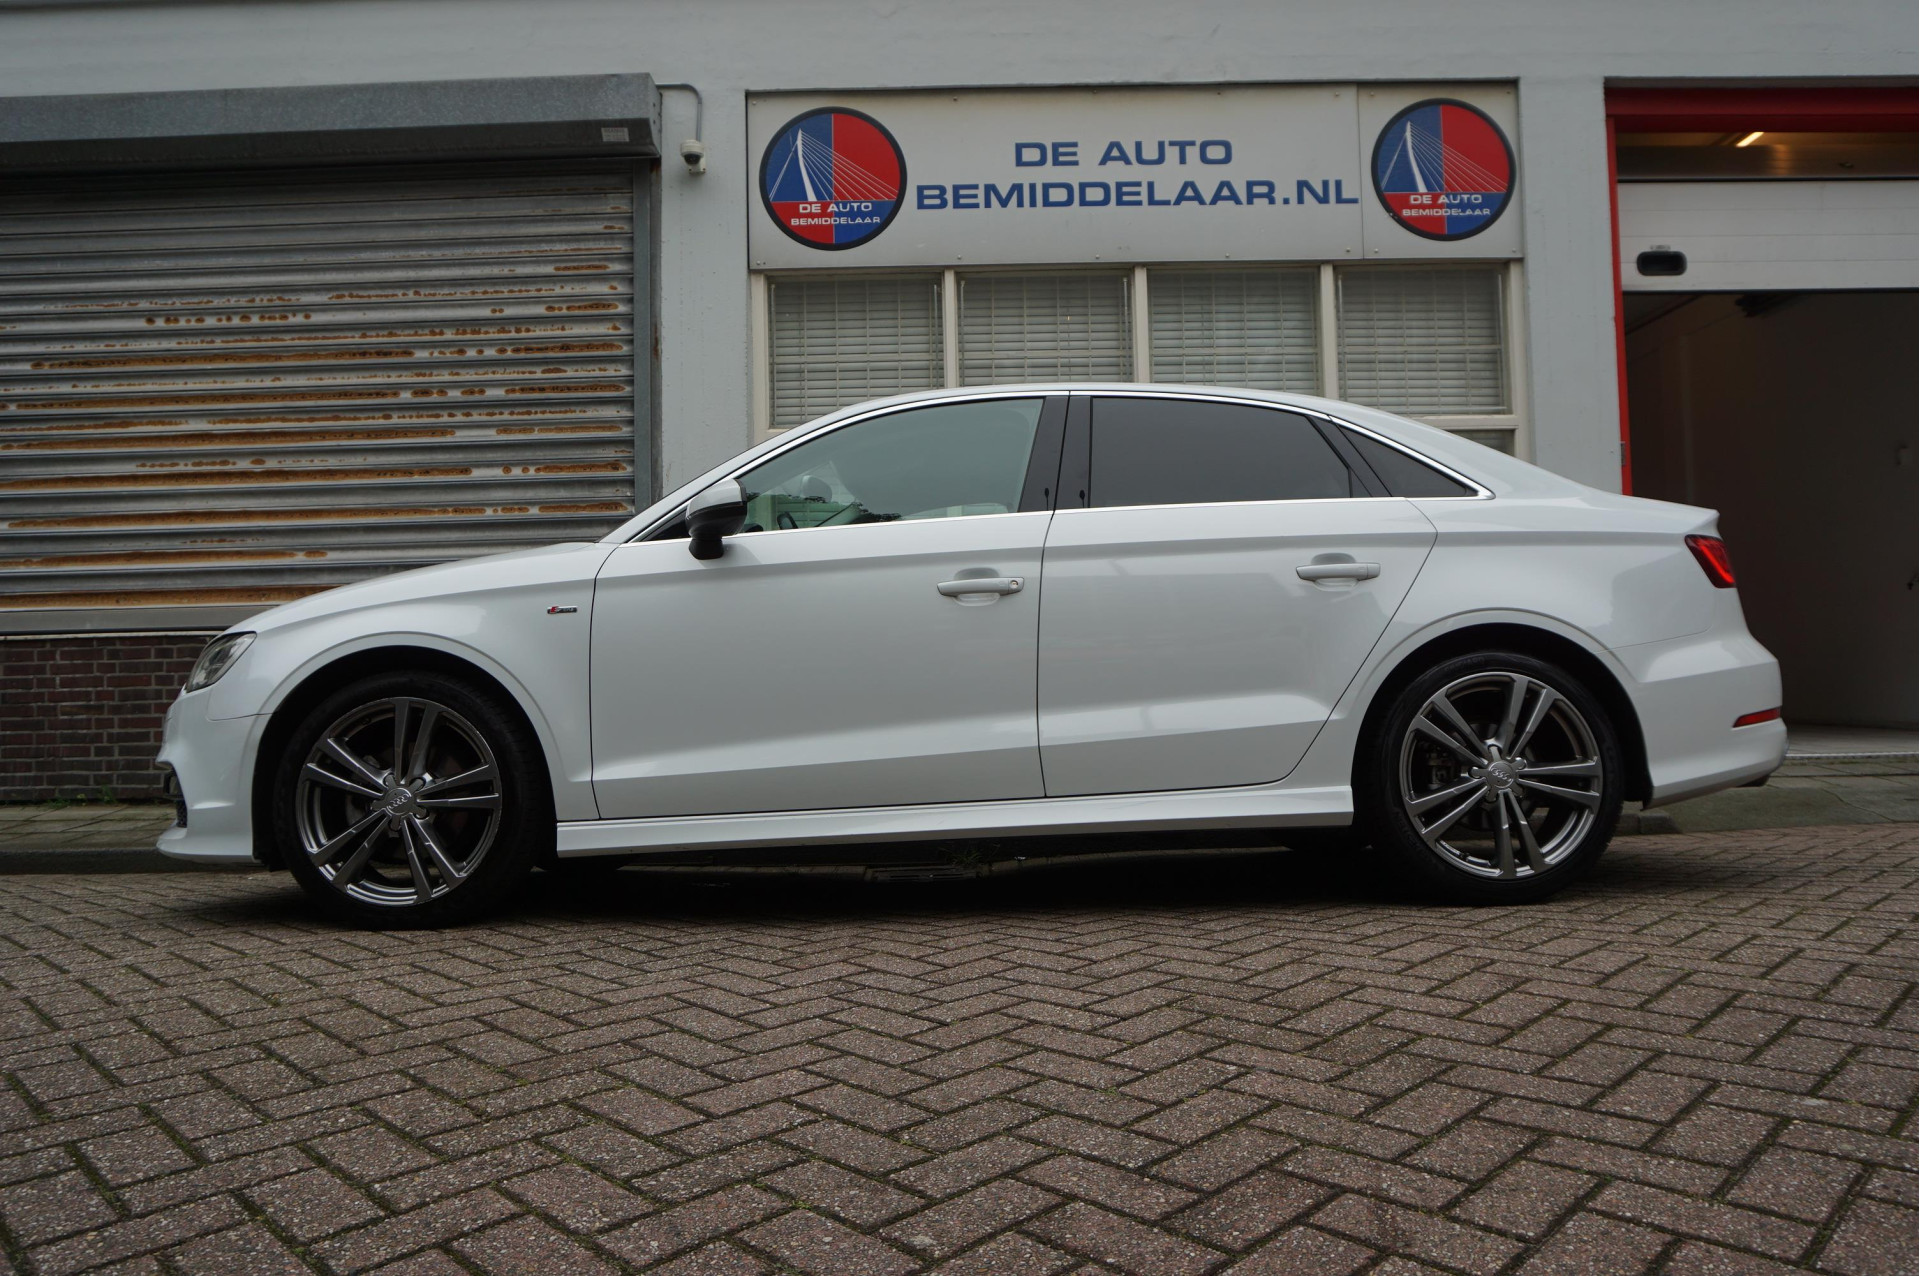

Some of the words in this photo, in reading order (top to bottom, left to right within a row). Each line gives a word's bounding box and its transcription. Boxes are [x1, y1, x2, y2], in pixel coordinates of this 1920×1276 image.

[1015, 141, 1079, 167] DE
[1098, 139, 1233, 167] AUTO
[916, 179, 1359, 210] BEMIDDELAAR.NL
[1409, 194, 1432, 204] DE
[1437, 194, 1482, 204] AUTO
[799, 203, 822, 213] DE
[827, 202, 873, 212] AUTO
[1402, 208, 1491, 216] BEMIDDELAAR
[790, 216, 881, 226] BEMIDDELAAR
